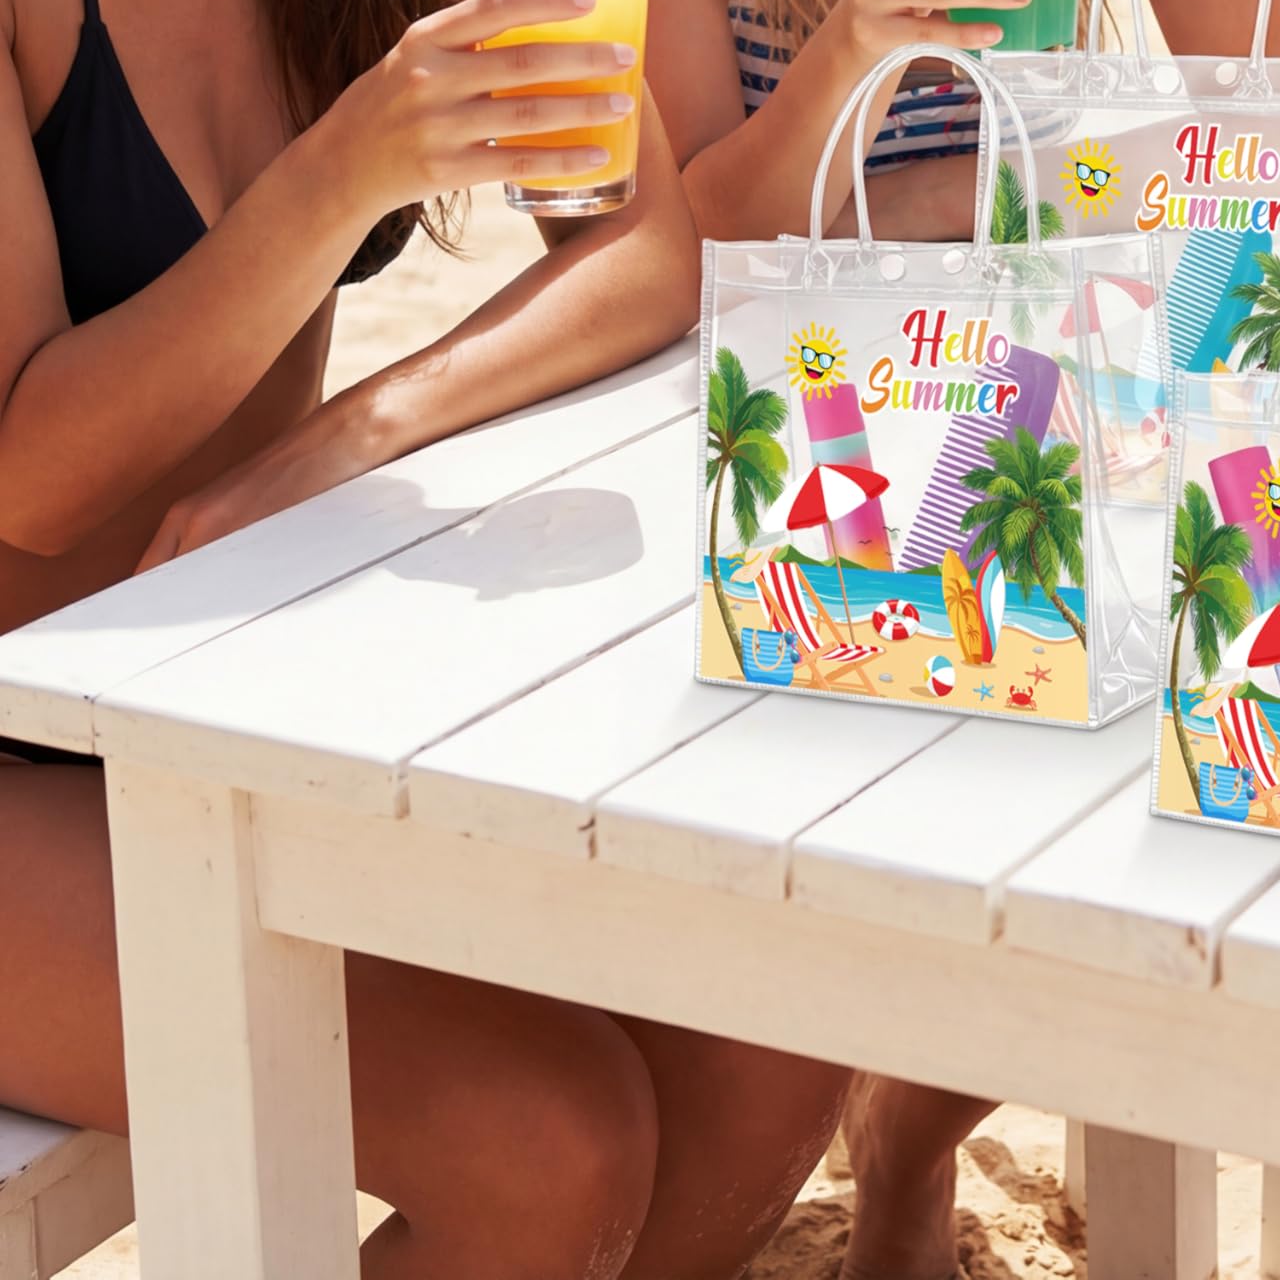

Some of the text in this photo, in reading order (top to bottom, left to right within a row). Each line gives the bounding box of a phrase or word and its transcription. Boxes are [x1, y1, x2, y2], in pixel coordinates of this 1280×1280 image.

[1176, 126, 1279, 184] Hello
[902, 309, 1009, 367] Hello
[860, 357, 1017, 414] Summer
